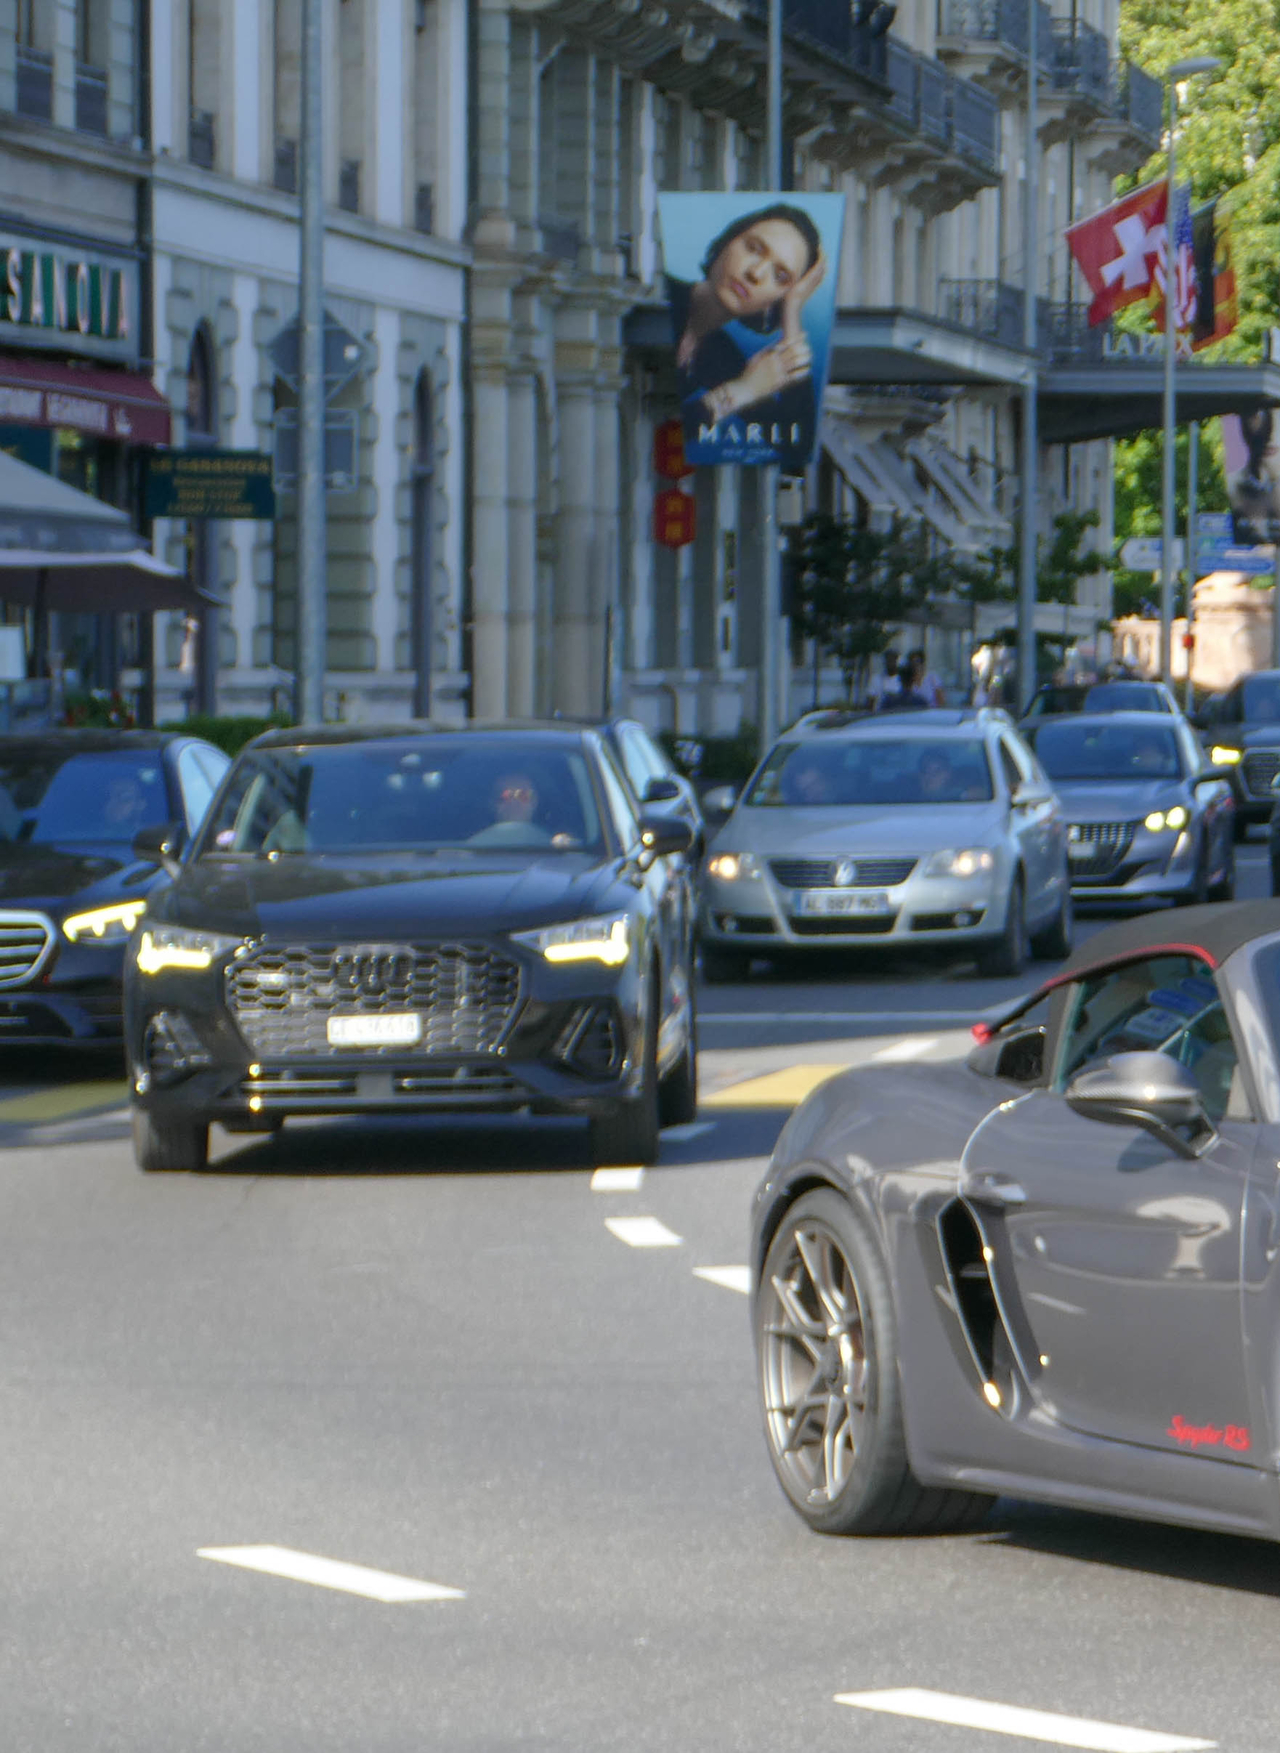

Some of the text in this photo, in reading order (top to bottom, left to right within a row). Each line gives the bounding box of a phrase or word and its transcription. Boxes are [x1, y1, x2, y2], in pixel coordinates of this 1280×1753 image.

[7, 247, 128, 339] SANOVA
[699, 422, 799, 444] MARLI
[1166, 1414, 1250, 1452] Spyder RS
